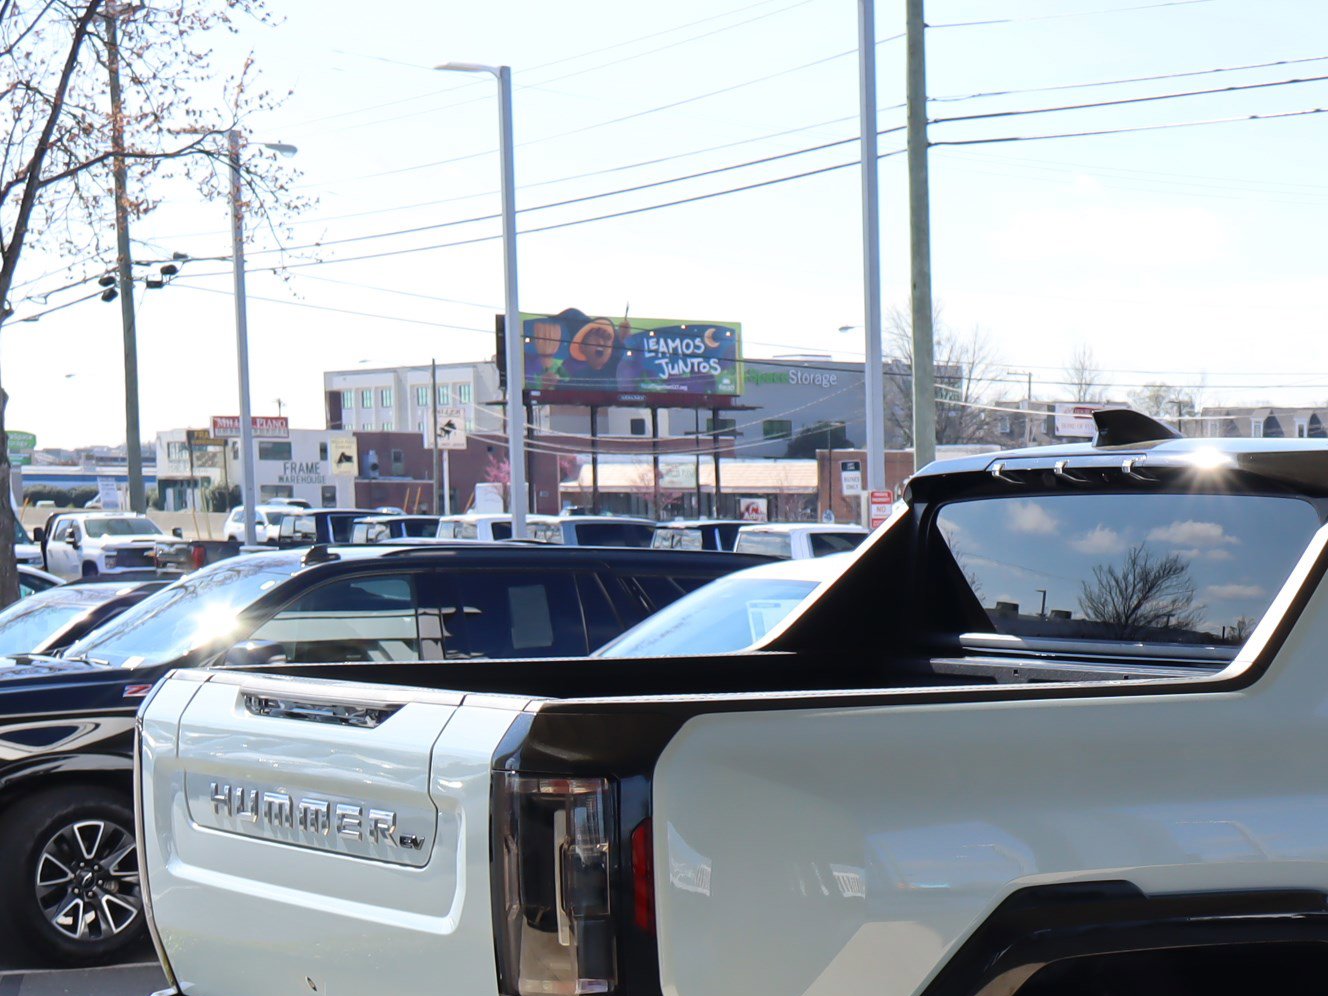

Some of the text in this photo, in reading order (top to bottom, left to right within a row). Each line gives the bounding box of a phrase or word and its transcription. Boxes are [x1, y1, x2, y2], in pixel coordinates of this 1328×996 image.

[643, 337, 705, 358] LEAMOS
[788, 369, 838, 388] Storage
[283, 461, 321, 475] FRAME
[278, 475, 326, 485] WAREHOUSE
[210, 782, 425, 850] HUMMER EV
